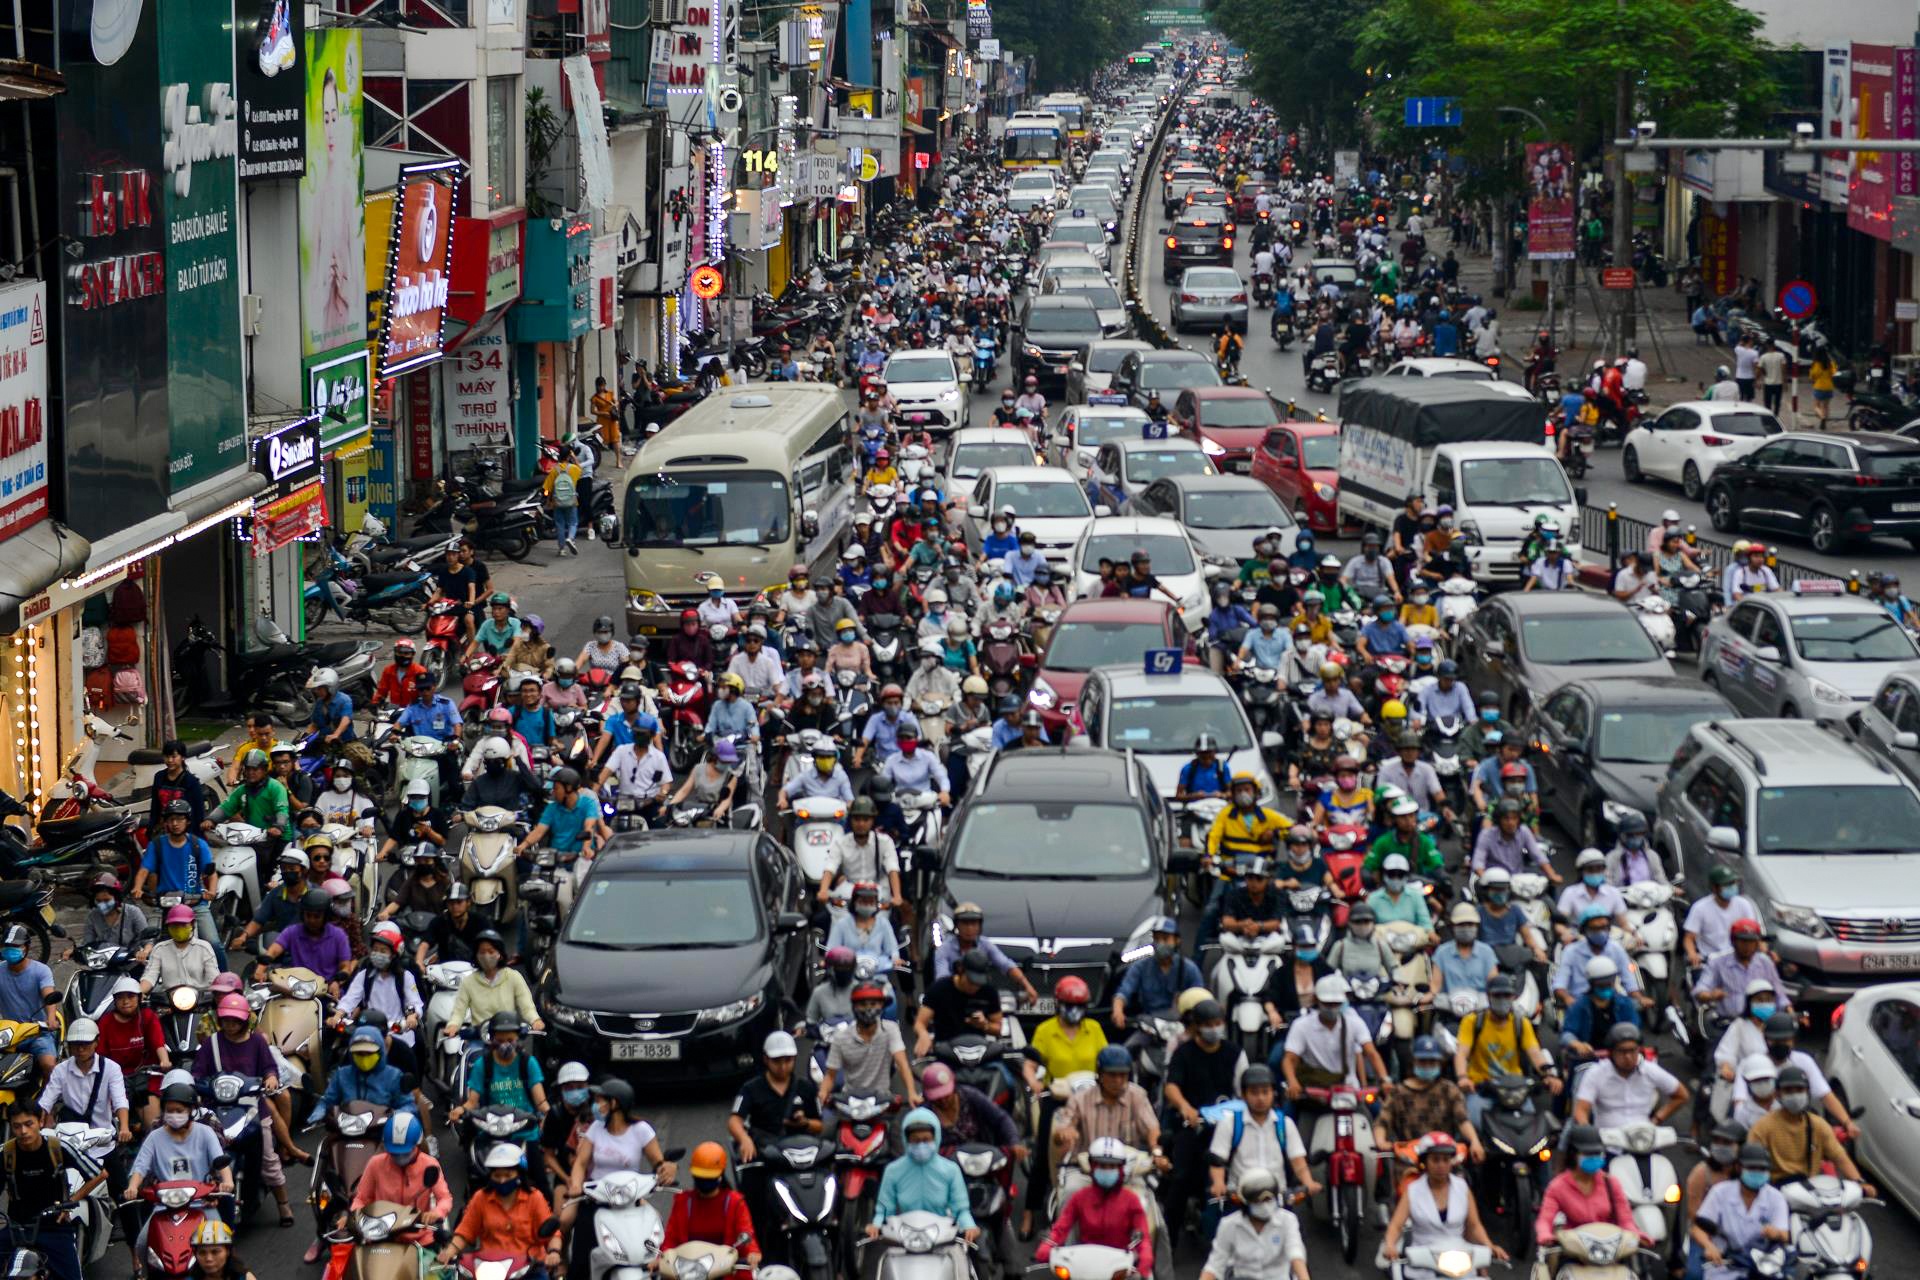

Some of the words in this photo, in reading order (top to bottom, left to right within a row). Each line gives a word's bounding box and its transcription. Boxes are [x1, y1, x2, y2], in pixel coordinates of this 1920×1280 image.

[742, 150, 777, 172] 114
[813, 184, 834, 195] 104
[81, 251, 165, 311] SNEAKER
[456, 350, 503, 371] 134
[458, 378, 496, 394] MÁY
[461, 400, 498, 419] TRỢ
[455, 419, 507, 434] THÍNH
[188, 854, 198, 888] AERO
[619, 1044, 672, 1057] 31F-1838
